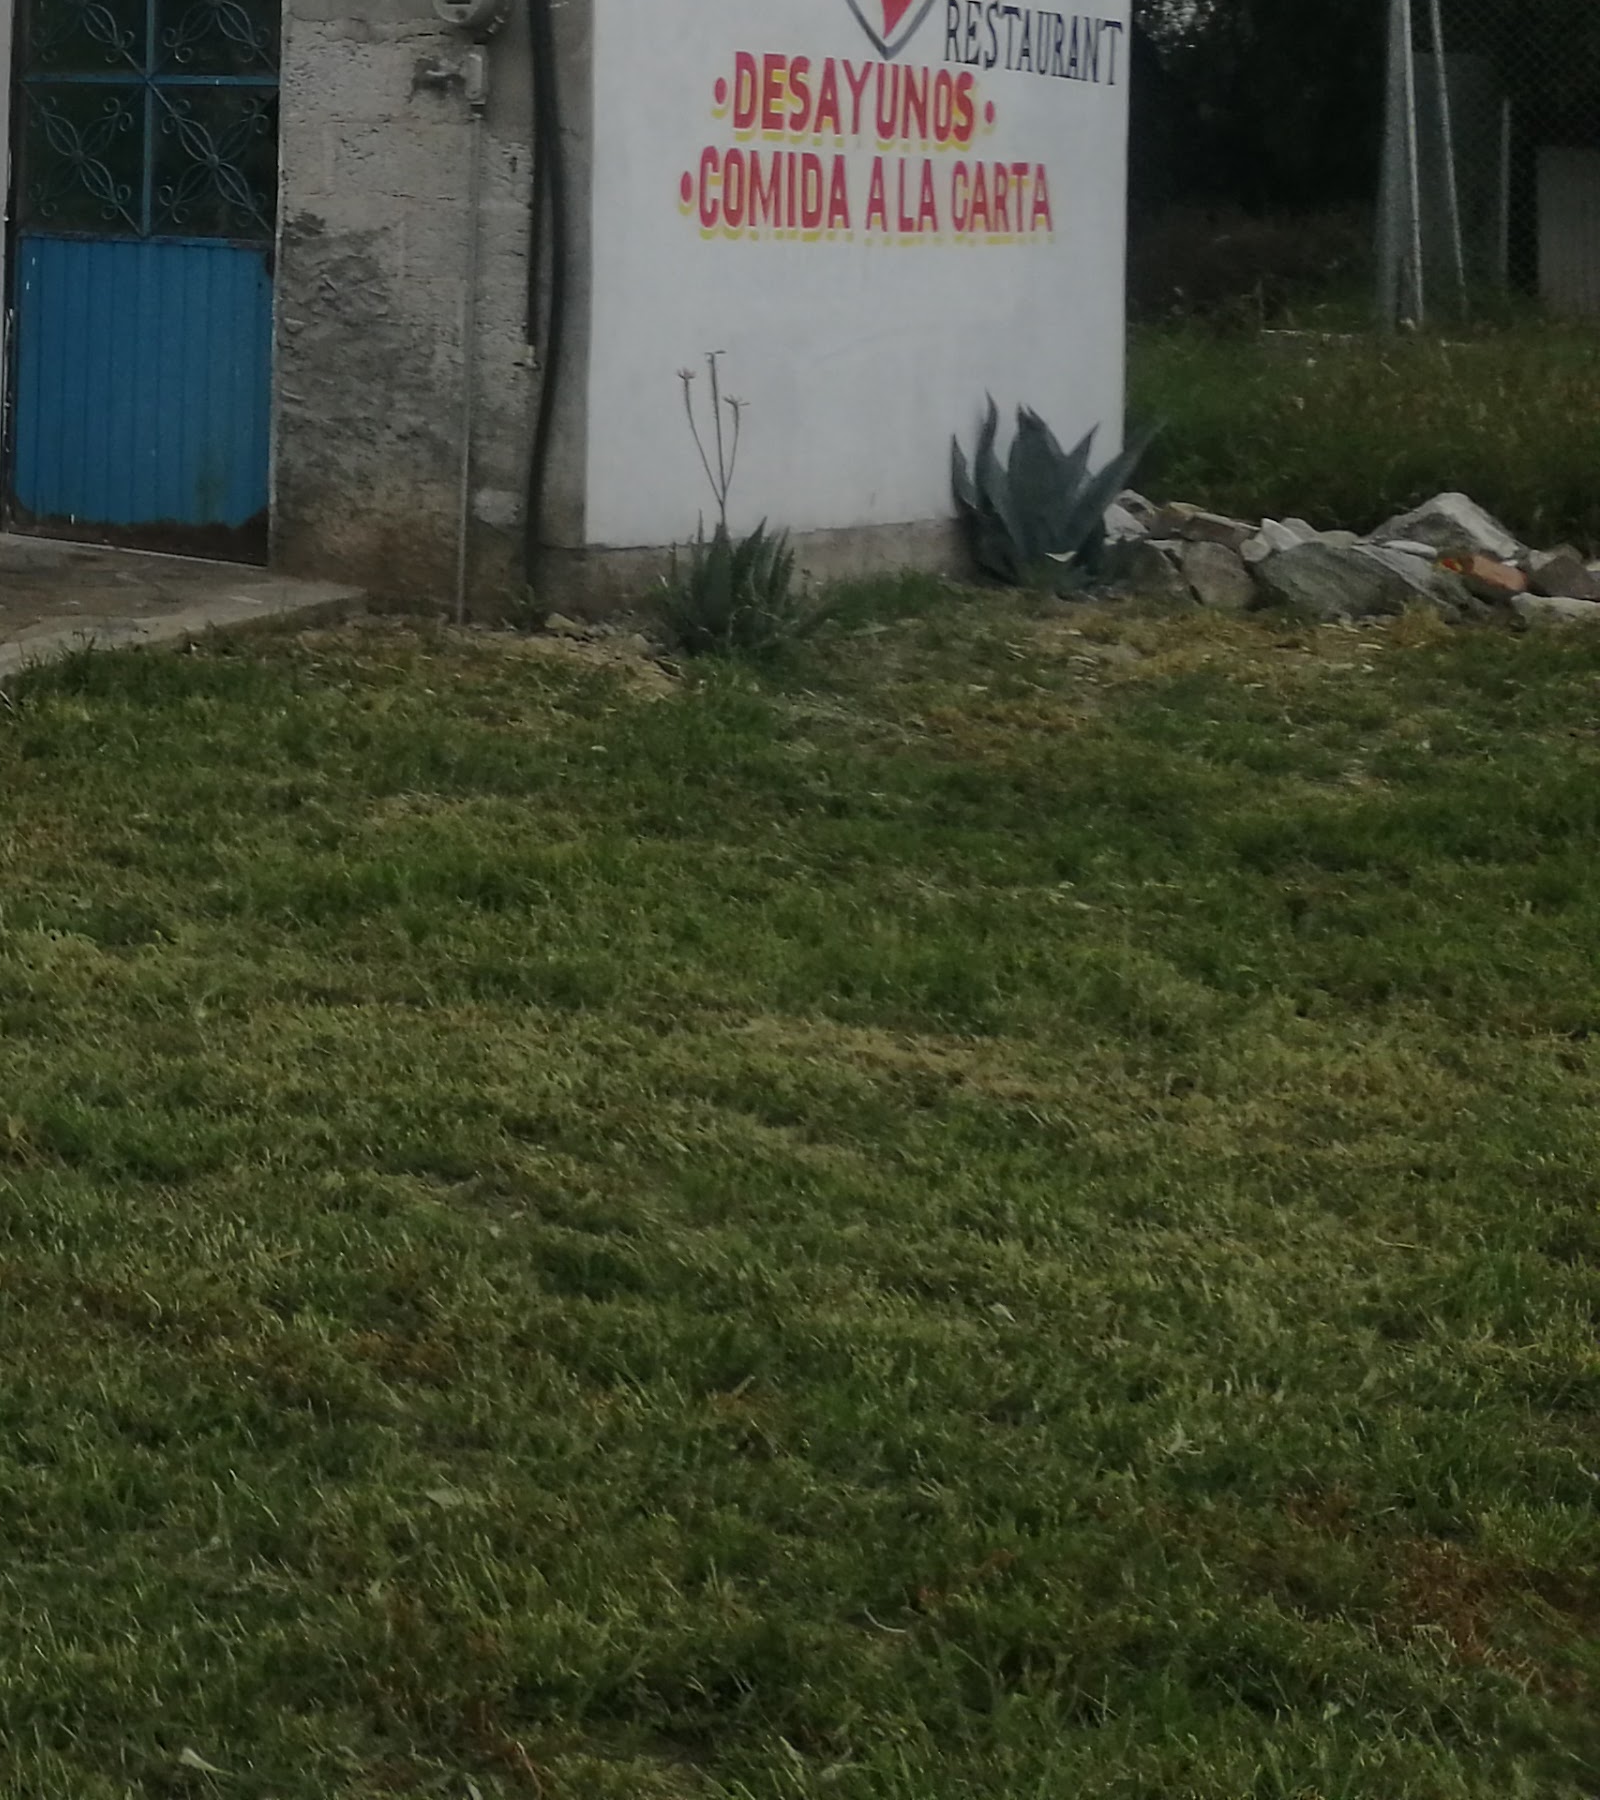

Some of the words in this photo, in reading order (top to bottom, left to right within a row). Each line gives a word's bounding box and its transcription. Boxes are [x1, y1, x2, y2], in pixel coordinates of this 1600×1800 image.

[732, 51, 976, 144] DESAYUNOS
[698, 144, 851, 232] COMIDA
[865, 156, 888, 233] A
[897, 157, 939, 234] LA
[951, 160, 1054, 234] CARTA
